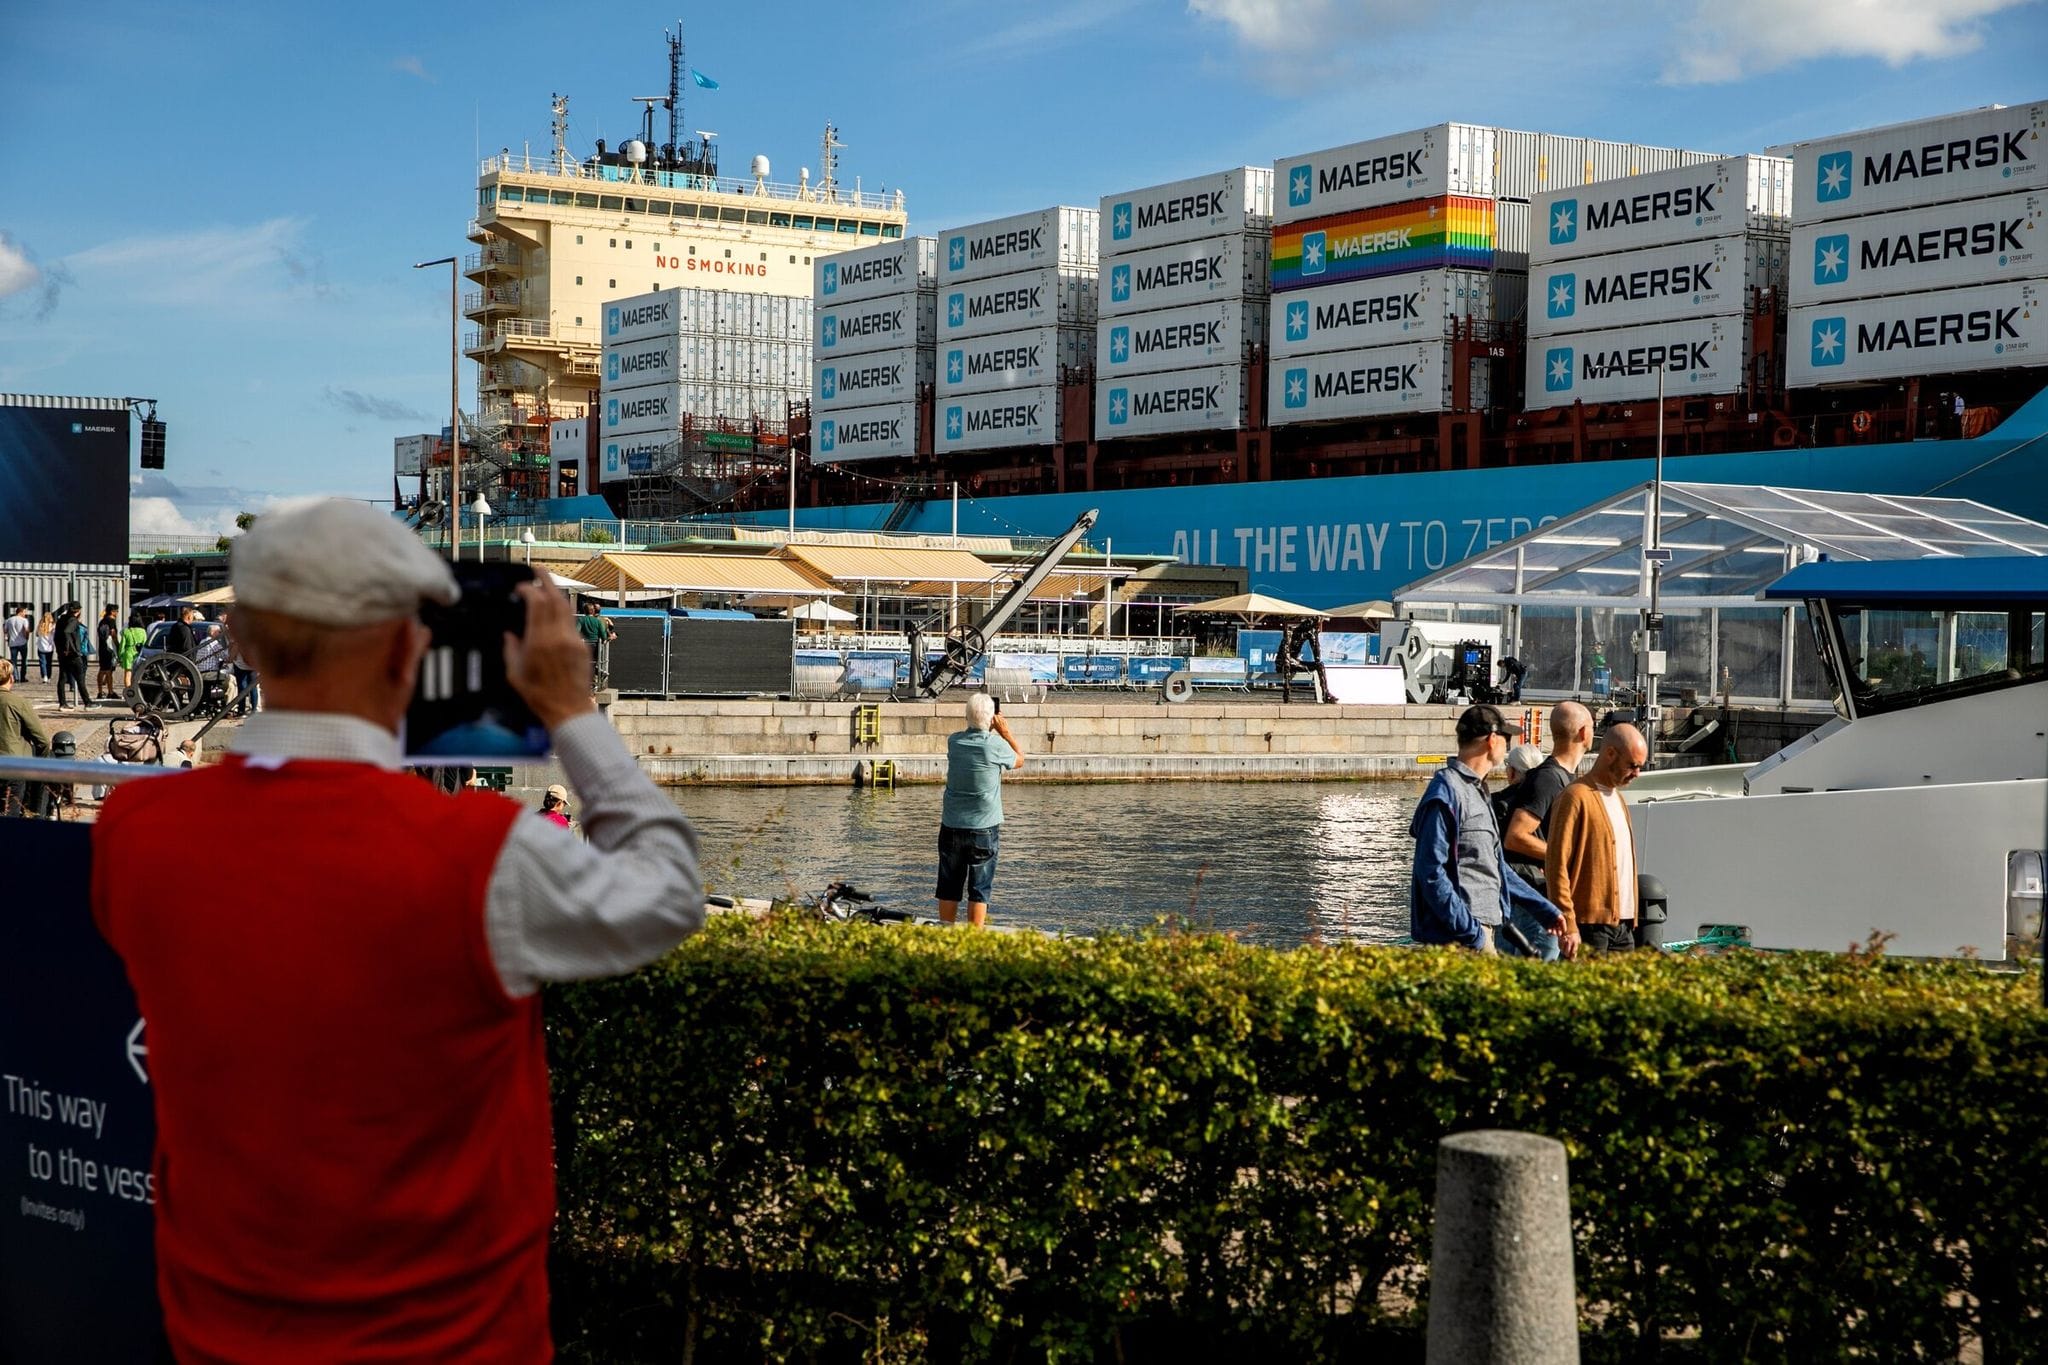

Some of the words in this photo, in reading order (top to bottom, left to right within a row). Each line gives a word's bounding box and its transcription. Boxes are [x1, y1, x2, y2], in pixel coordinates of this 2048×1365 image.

[1319, 149, 1421, 192] MAERSK
[1863, 129, 2027, 185] MAERSK
[1137, 190, 1222, 227] MAERSK
[1586, 184, 1714, 229] MAERSK
[970, 227, 1040, 259] MAERSK
[1334, 227, 1411, 258] MAERSK
[1860, 218, 2023, 268] MAERSK
[657, 256, 679, 269] NO
[687, 258, 767, 277] SMOKING
[841, 256, 901, 284] MAERSK
[1136, 256, 1221, 290] MAERSK
[1584, 263, 1711, 304] MAERSK
[622, 303, 667, 326] MAERSK
[969, 287, 1039, 317] MAERSK
[1316, 293, 1418, 329] MAERSK
[840, 310, 900, 337] MAERSK
[1135, 321, 1219, 352] MAERSK
[1857, 307, 2019, 352] MAERSK
[621, 350, 667, 372] MAERSK
[968, 346, 1038, 373] MAERSK
[1490, 347, 1505, 357] 1AS
[1582, 341, 1709, 383] MAERSK
[839, 365, 899, 390] MAERSK
[1314, 364, 1415, 397] MAERSK
[621, 397, 666, 418] MAERSK
[1133, 385, 1217, 414] MAERSK
[85, 425, 116, 433] MAERSK
[838, 420, 898, 442] MAERSK
[967, 405, 1037, 430] MAERSK
[1172, 530, 1226, 566] ALL
[1234, 527, 1297, 573] THE
[1307, 522, 1390, 572] WAY
[1400, 520, 1447, 570] TO
[1462, 515, 1559, 560] ZE
[1265, 653, 1303, 662] MAK
[3, 1075, 53, 1121] This
[57, 1093, 107, 1140] way
[29, 1143, 52, 1181] to
[59, 1148, 98, 1191] the
[104, 1164, 157, 1205] vess
